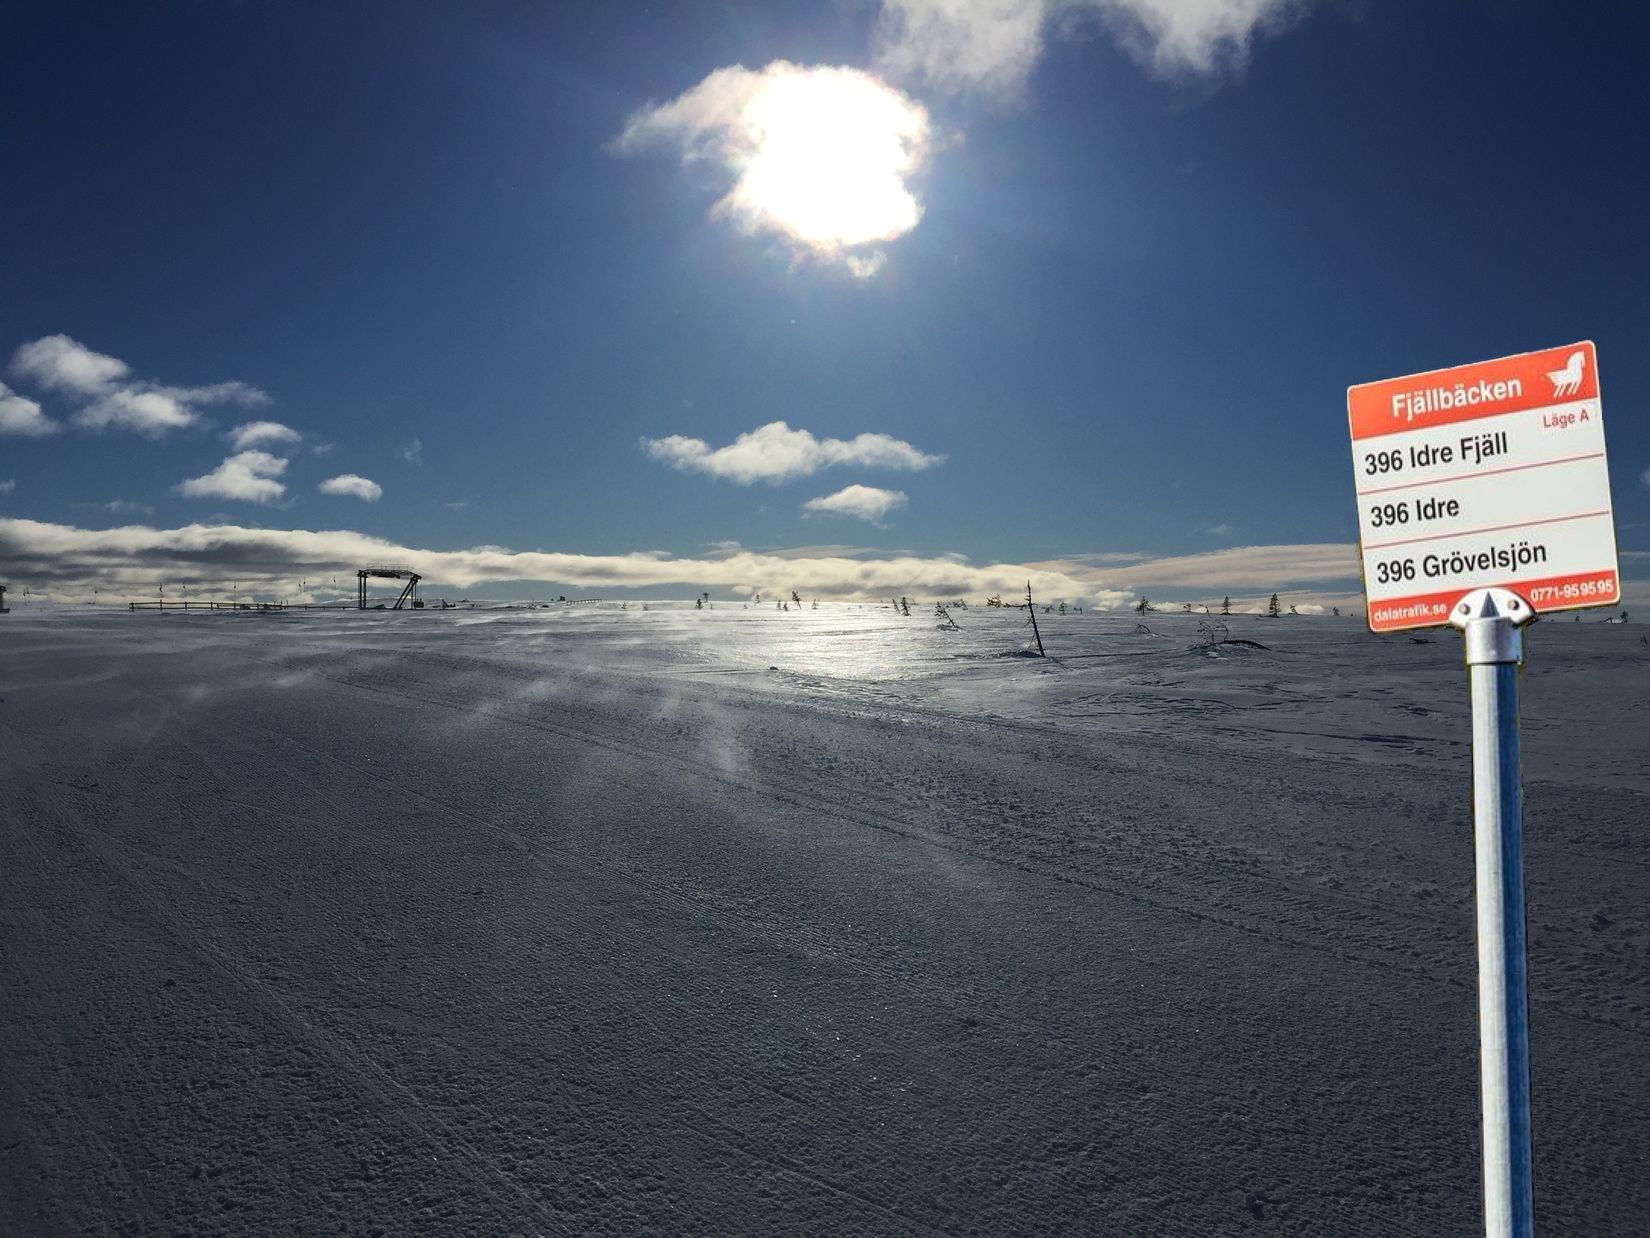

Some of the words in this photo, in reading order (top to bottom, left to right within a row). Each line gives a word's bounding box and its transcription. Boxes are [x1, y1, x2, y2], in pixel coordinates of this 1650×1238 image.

[1391, 379, 1523, 421] Fjällbäcken
[1543, 413, 1576, 429] Läge
[1579, 408, 1590, 422] A
[1364, 449, 1403, 475] 396
[1410, 444, 1453, 468] Idre
[1460, 431, 1508, 464] Fjäll
[1370, 502, 1409, 527] 396
[1416, 497, 1460, 521] Idre
[1377, 559, 1415, 584] 396
[1423, 541, 1547, 577] Grövelsjön
[1374, 603, 1447, 622] dalatrafik.se
